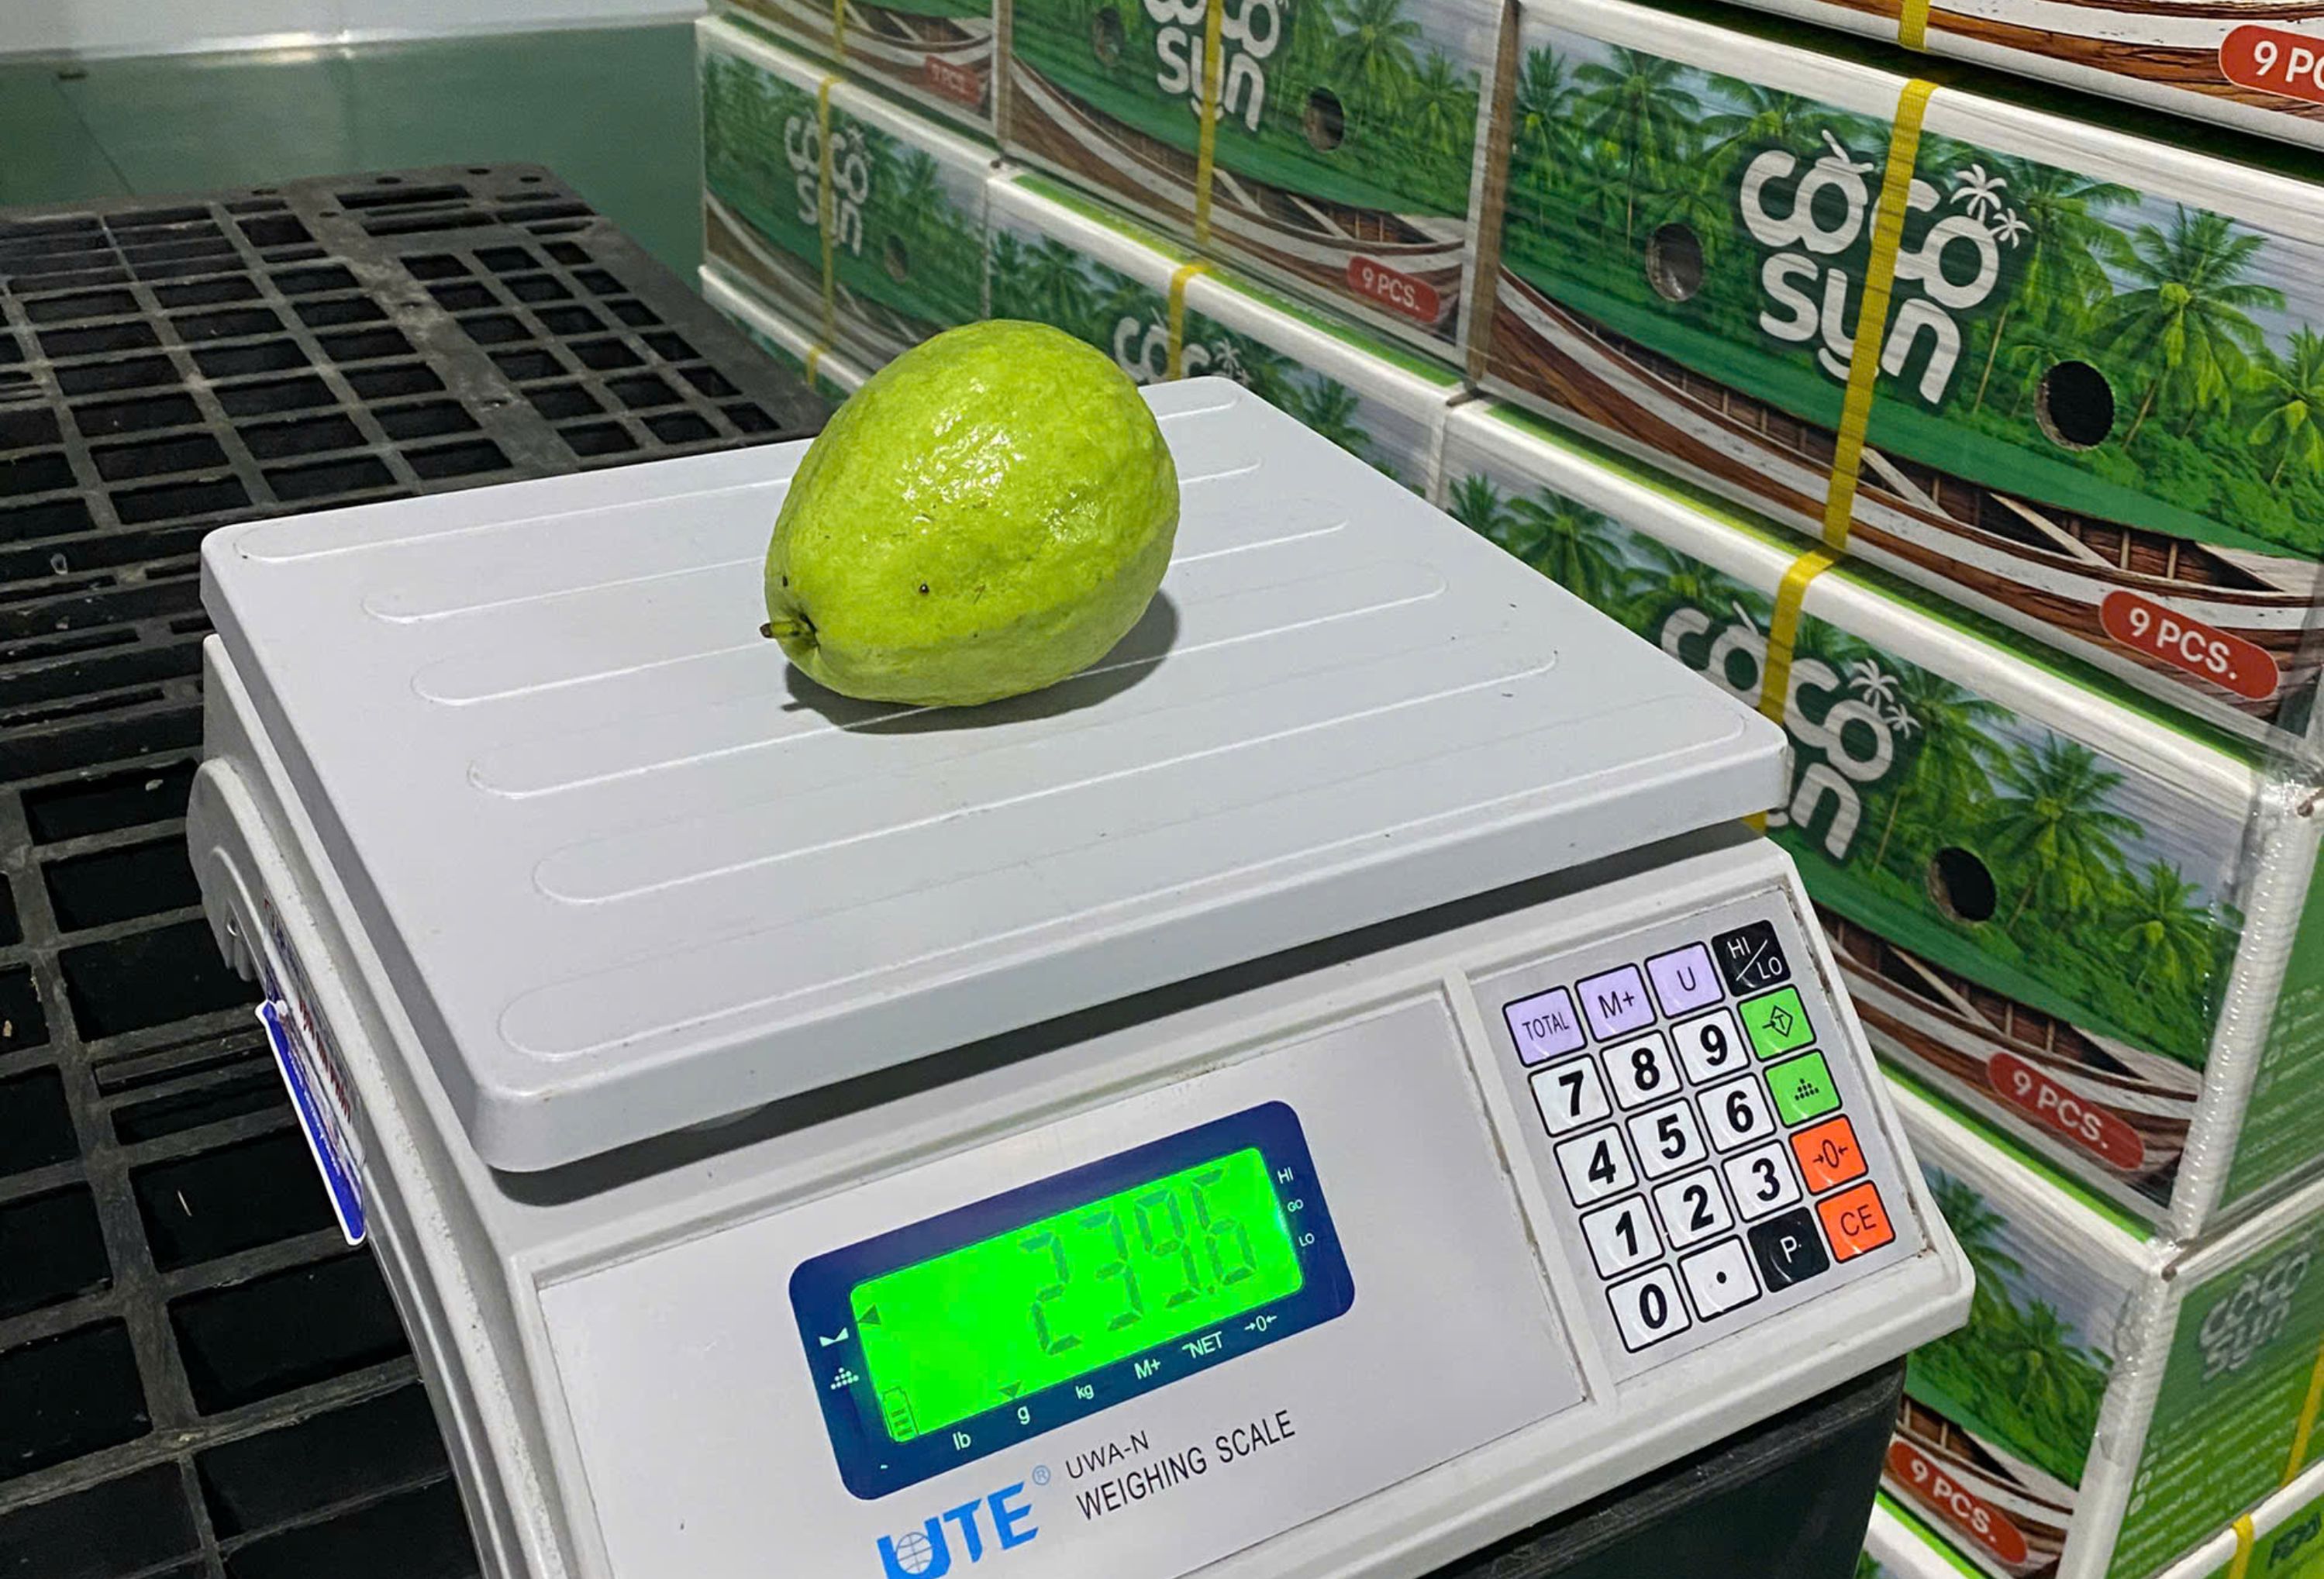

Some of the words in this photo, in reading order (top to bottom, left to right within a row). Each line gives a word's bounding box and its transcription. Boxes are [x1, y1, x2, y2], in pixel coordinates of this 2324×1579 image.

[2253, 40, 2278, 76] 9
[1362, 266, 1374, 290] 9
[1378, 273, 1421, 312] PCS.
[2129, 607, 2150, 637] 9
[2156, 619, 2237, 681] PCS.
[1727, 936, 1752, 960] HI
[1759, 955, 1783, 981] LO
[1676, 967, 1697, 992] U
[1598, 990, 1635, 1019] M+
[1522, 1012, 1571, 1042] TOTAL
[1700, 1024, 1728, 1067] 9
[1633, 1048, 1660, 1091] 8
[1558, 1070, 1585, 1117] 7
[1726, 1091, 1754, 1133] 6
[2013, 1070, 2032, 1095] 9
[2036, 1084, 2108, 1150] PCS.
[1657, 1114, 1687, 1160] 5
[1277, 1167, 1294, 1184] HI
[1588, 1139, 1617, 1184] 4
[1751, 1158, 1781, 1201] 3
[1287, 1198, 1304, 1212] GO
[1684, 1185, 1714, 1231] 2
[1840, 1204, 1877, 1237] CE
[1298, 1233, 1315, 1247] LO
[1615, 1211, 1639, 1257] 1
[1780, 1236, 1798, 1264] P
[1638, 1284, 1667, 1329] 0
[953, 1432, 972, 1451] lb
[1017, 1405, 1031, 1425] g
[1075, 1383, 1095, 1401] kg
[1134, 1358, 1162, 1380] M+
[1065, 1430, 1150, 1481] UWA-N
[1076, 1446, 1209, 1522] WEIGHING
[1215, 1409, 1296, 1464] SCALE
[1911, 1459, 1929, 1482] 9
[1933, 1476, 1997, 1543] PCS.
